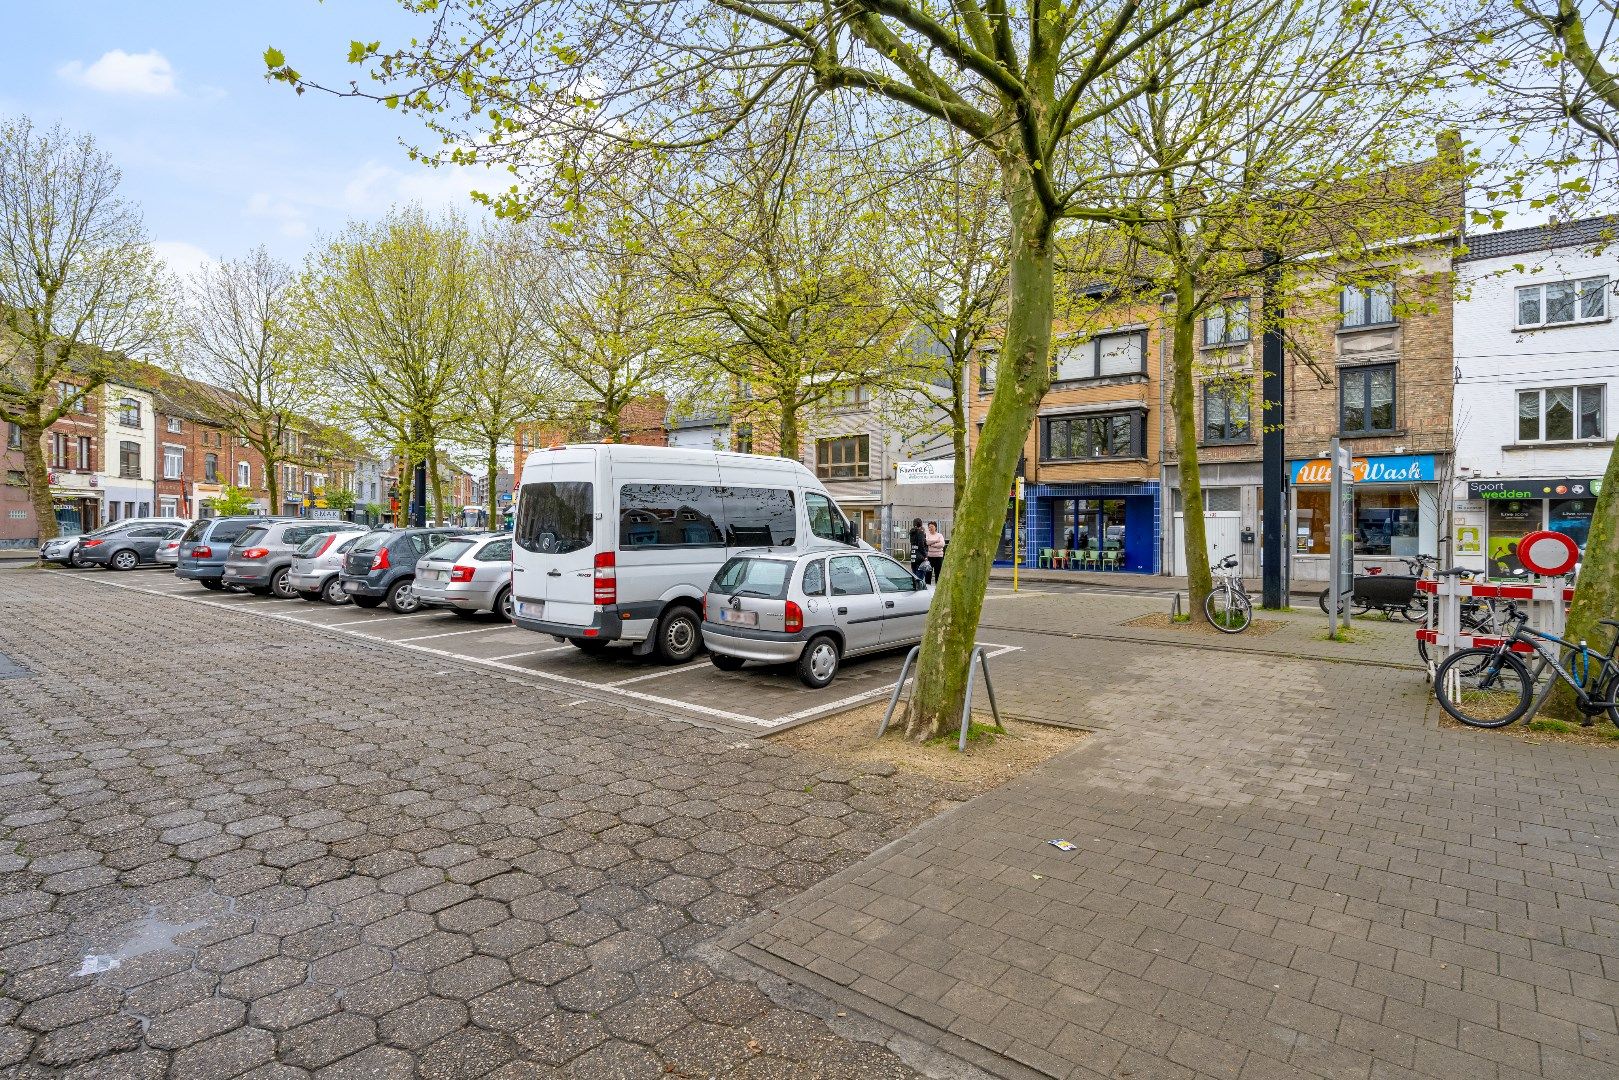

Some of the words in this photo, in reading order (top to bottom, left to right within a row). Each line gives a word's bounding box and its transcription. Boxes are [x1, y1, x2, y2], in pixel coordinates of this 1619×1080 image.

[1360, 461, 1423, 481] Wash
[1470, 482, 1504, 492] Sport
[1481, 489, 1531, 498] wedden
